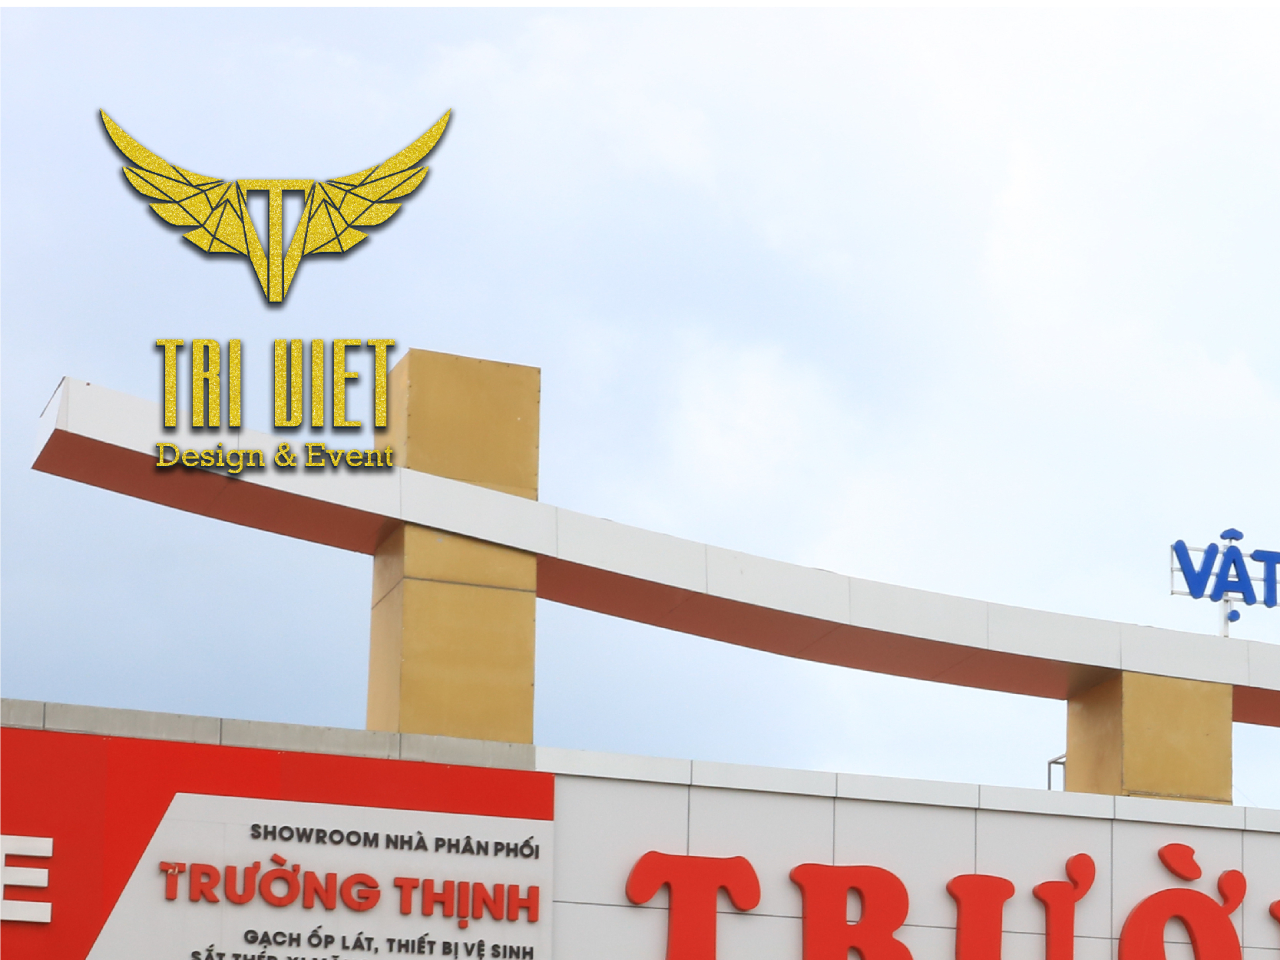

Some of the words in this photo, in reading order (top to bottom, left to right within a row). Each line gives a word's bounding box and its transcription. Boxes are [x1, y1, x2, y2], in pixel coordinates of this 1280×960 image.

[251, 823, 380, 848] SHOWROOM
[385, 831, 428, 852] NHÀ
[434, 835, 489, 856] PHÂN
[493, 836, 539, 859] PHỐI
[159, 852, 381, 912] TRƯỜNG
[394, 877, 540, 929] THỊNH
[244, 930, 301, 949] GẠCH
[307, 925, 335, 950] ỐP
[341, 931, 379, 954] LÁT,
[386, 933, 436, 955] THIẾT
[442, 941, 459, 960] BỊ
[463, 939, 485, 960] VỆ
[491, 944, 534, 960] SINH
